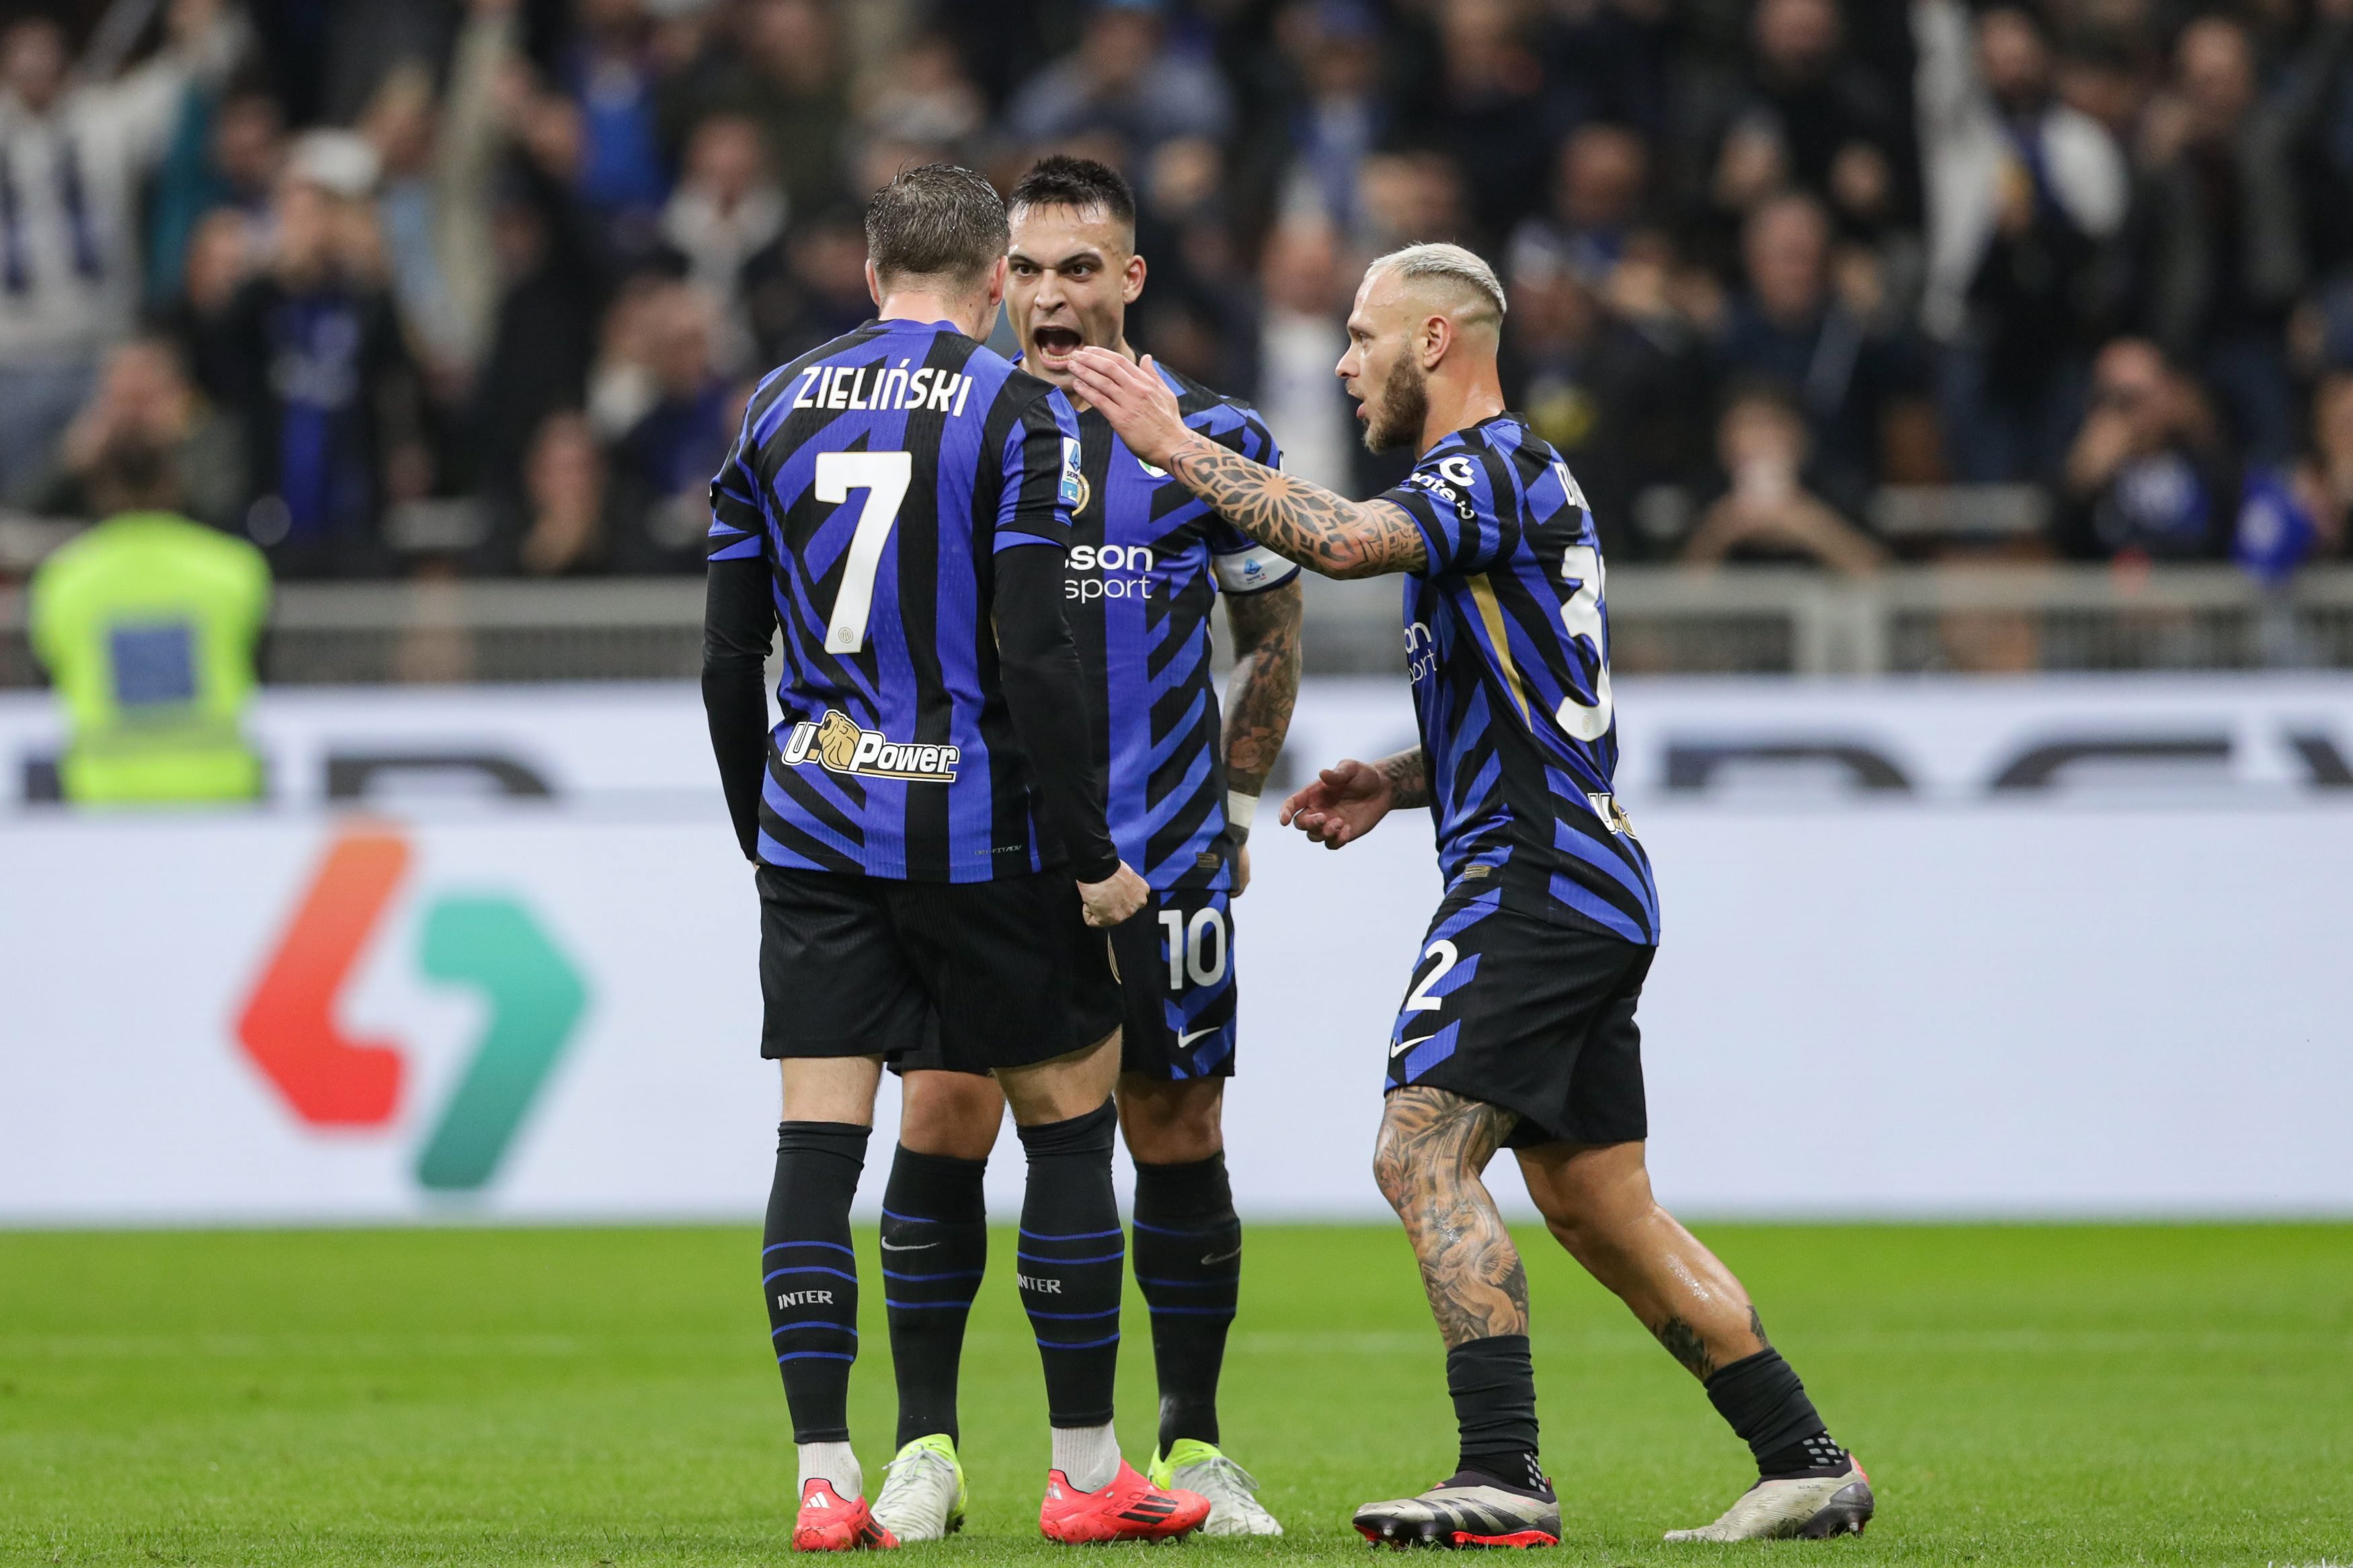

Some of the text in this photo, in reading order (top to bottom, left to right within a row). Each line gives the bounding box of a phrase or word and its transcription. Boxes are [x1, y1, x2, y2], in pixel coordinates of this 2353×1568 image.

[793, 358, 973, 417] ZIELIŃSKI
[815, 451, 912, 654] 7
[1065, 544, 1153, 571] son
[1065, 575, 1152, 604] sport
[1556, 545, 1613, 742] 3
[848, 731, 957, 772] Power
[1158, 907, 1226, 989] 10
[1400, 940, 1458, 1012] 2
[778, 1290, 833, 1310] INTER
